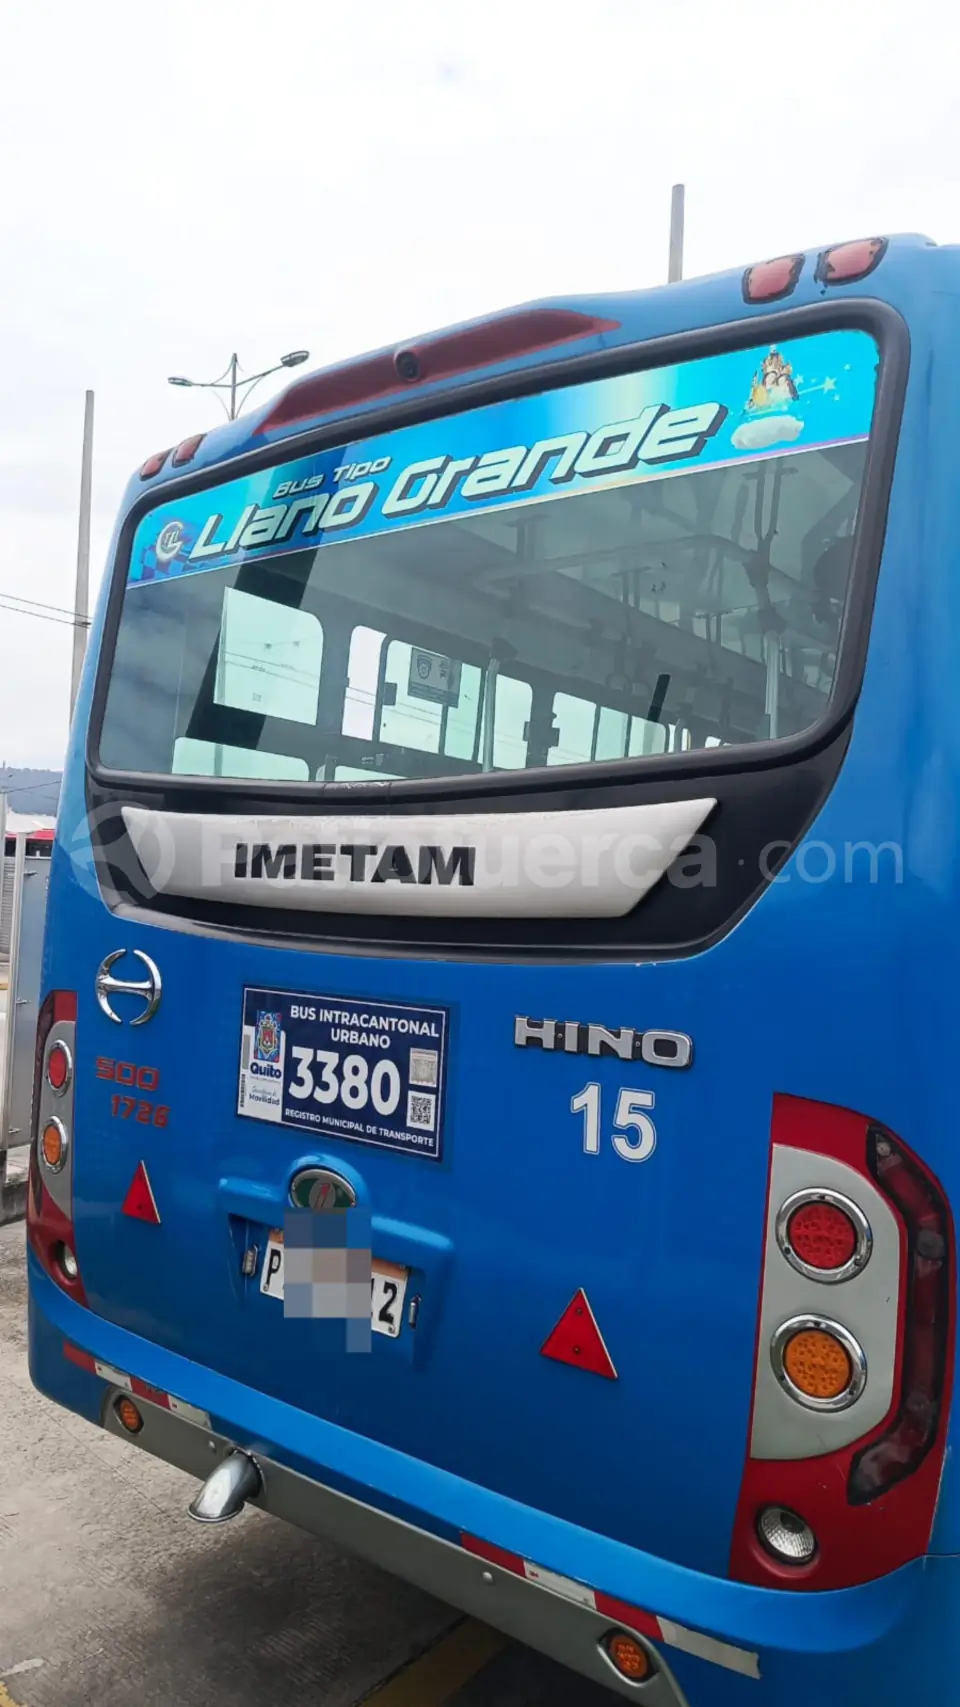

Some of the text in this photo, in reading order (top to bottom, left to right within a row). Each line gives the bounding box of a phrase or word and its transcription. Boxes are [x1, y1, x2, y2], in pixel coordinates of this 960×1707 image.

[188, 401, 728, 561] Llano Grande
[235, 842, 476, 887] IMETAM
[290, 1005, 439, 1037] BUS INTRACANTONAL
[331, 1027, 391, 1049] URBANO
[515, 1015, 692, 1069] HINO
[96, 1056, 160, 1091] 500
[250, 1061, 282, 1079] Quito
[288, 1045, 401, 1116] 3380
[112, 1094, 171, 1128] 1726
[284, 1108, 434, 1147] REGISTRO MUNICIPAL DE TRANSPORTE
[571, 1082, 657, 1163] 15
